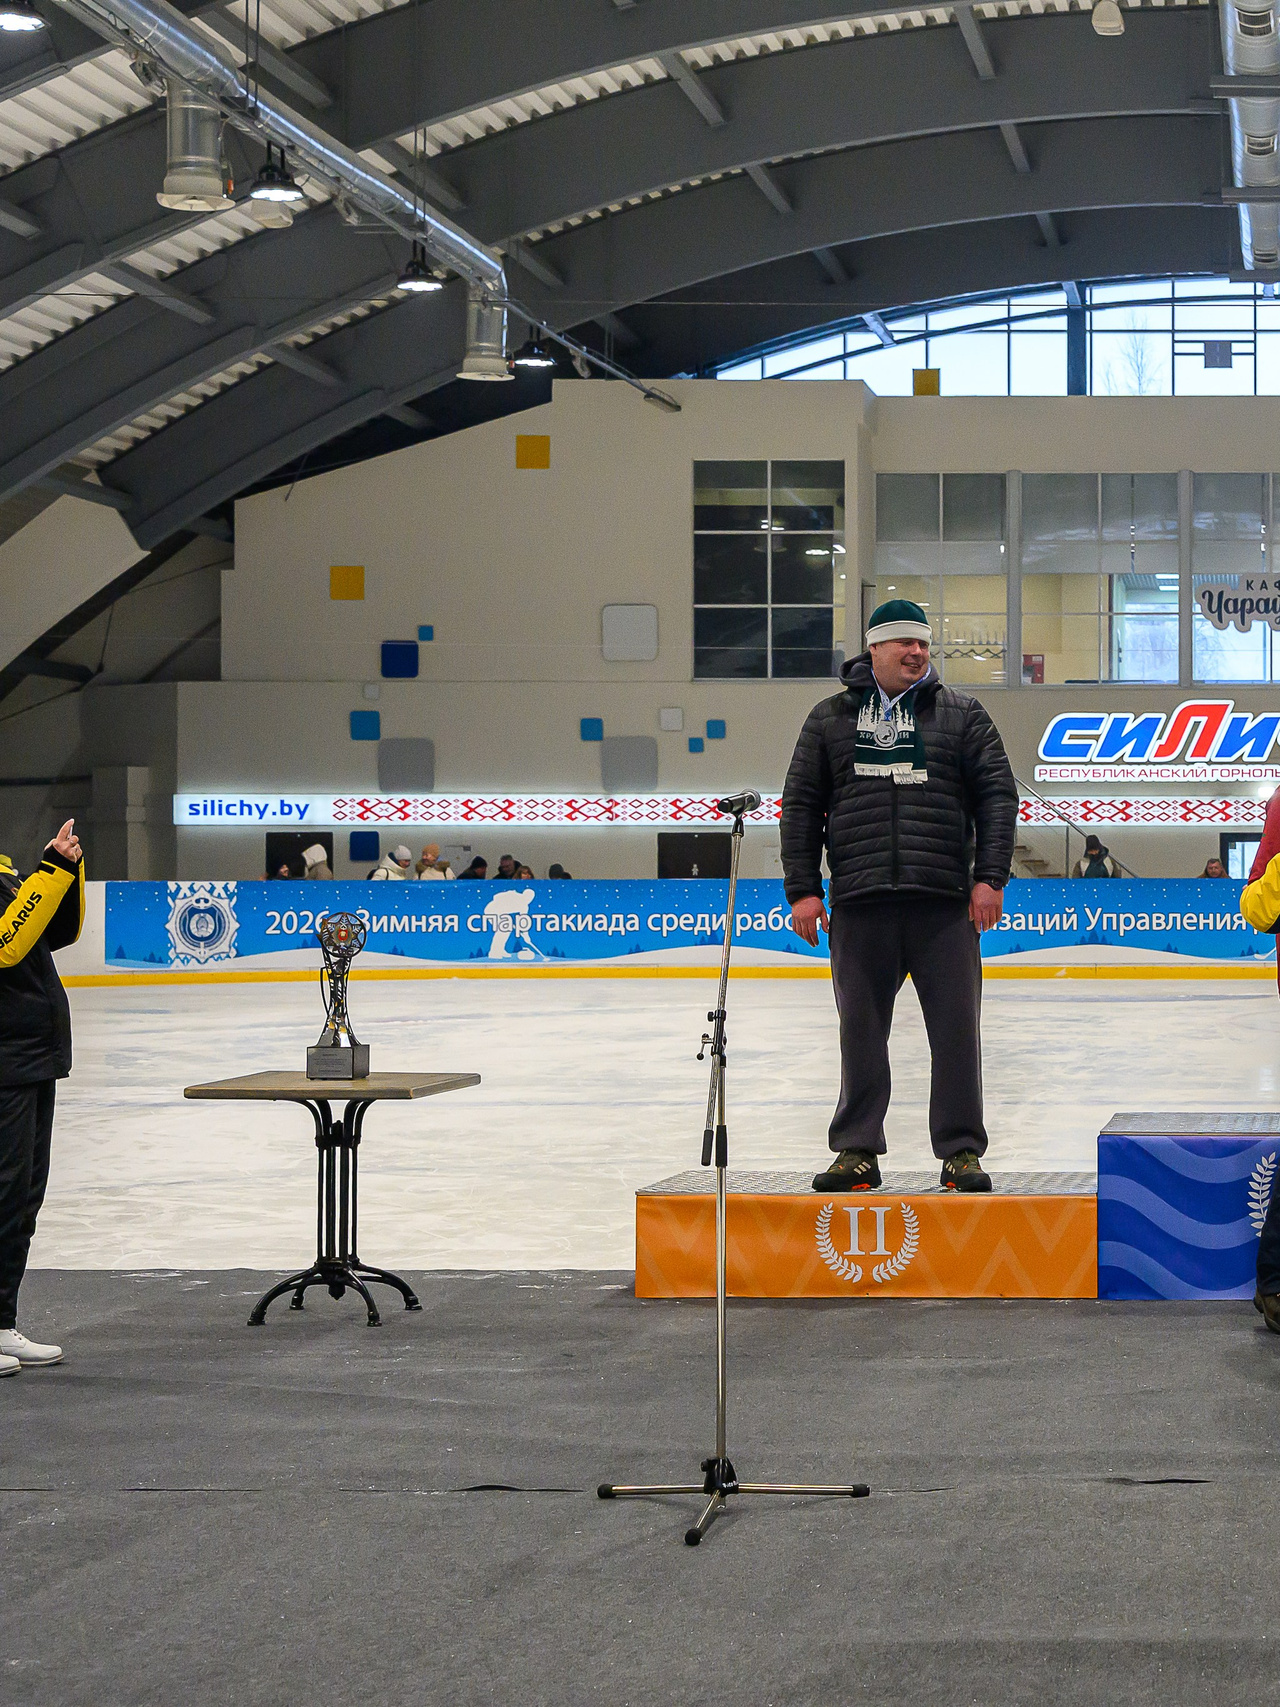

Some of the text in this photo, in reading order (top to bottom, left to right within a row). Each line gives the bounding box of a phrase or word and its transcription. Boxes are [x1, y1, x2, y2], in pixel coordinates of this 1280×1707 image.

[1038, 766, 1207, 779] РЕСПУБЛИКАНСКИЙ
[188, 799, 310, 820] silichy.by
[355, 909, 459, 934] Зимняя
[466, 913, 640, 937] спартакиада
[646, 913, 727, 937] среди
[1084, 907, 1247, 937] Управления
[842, 1206, 892, 1256] II
